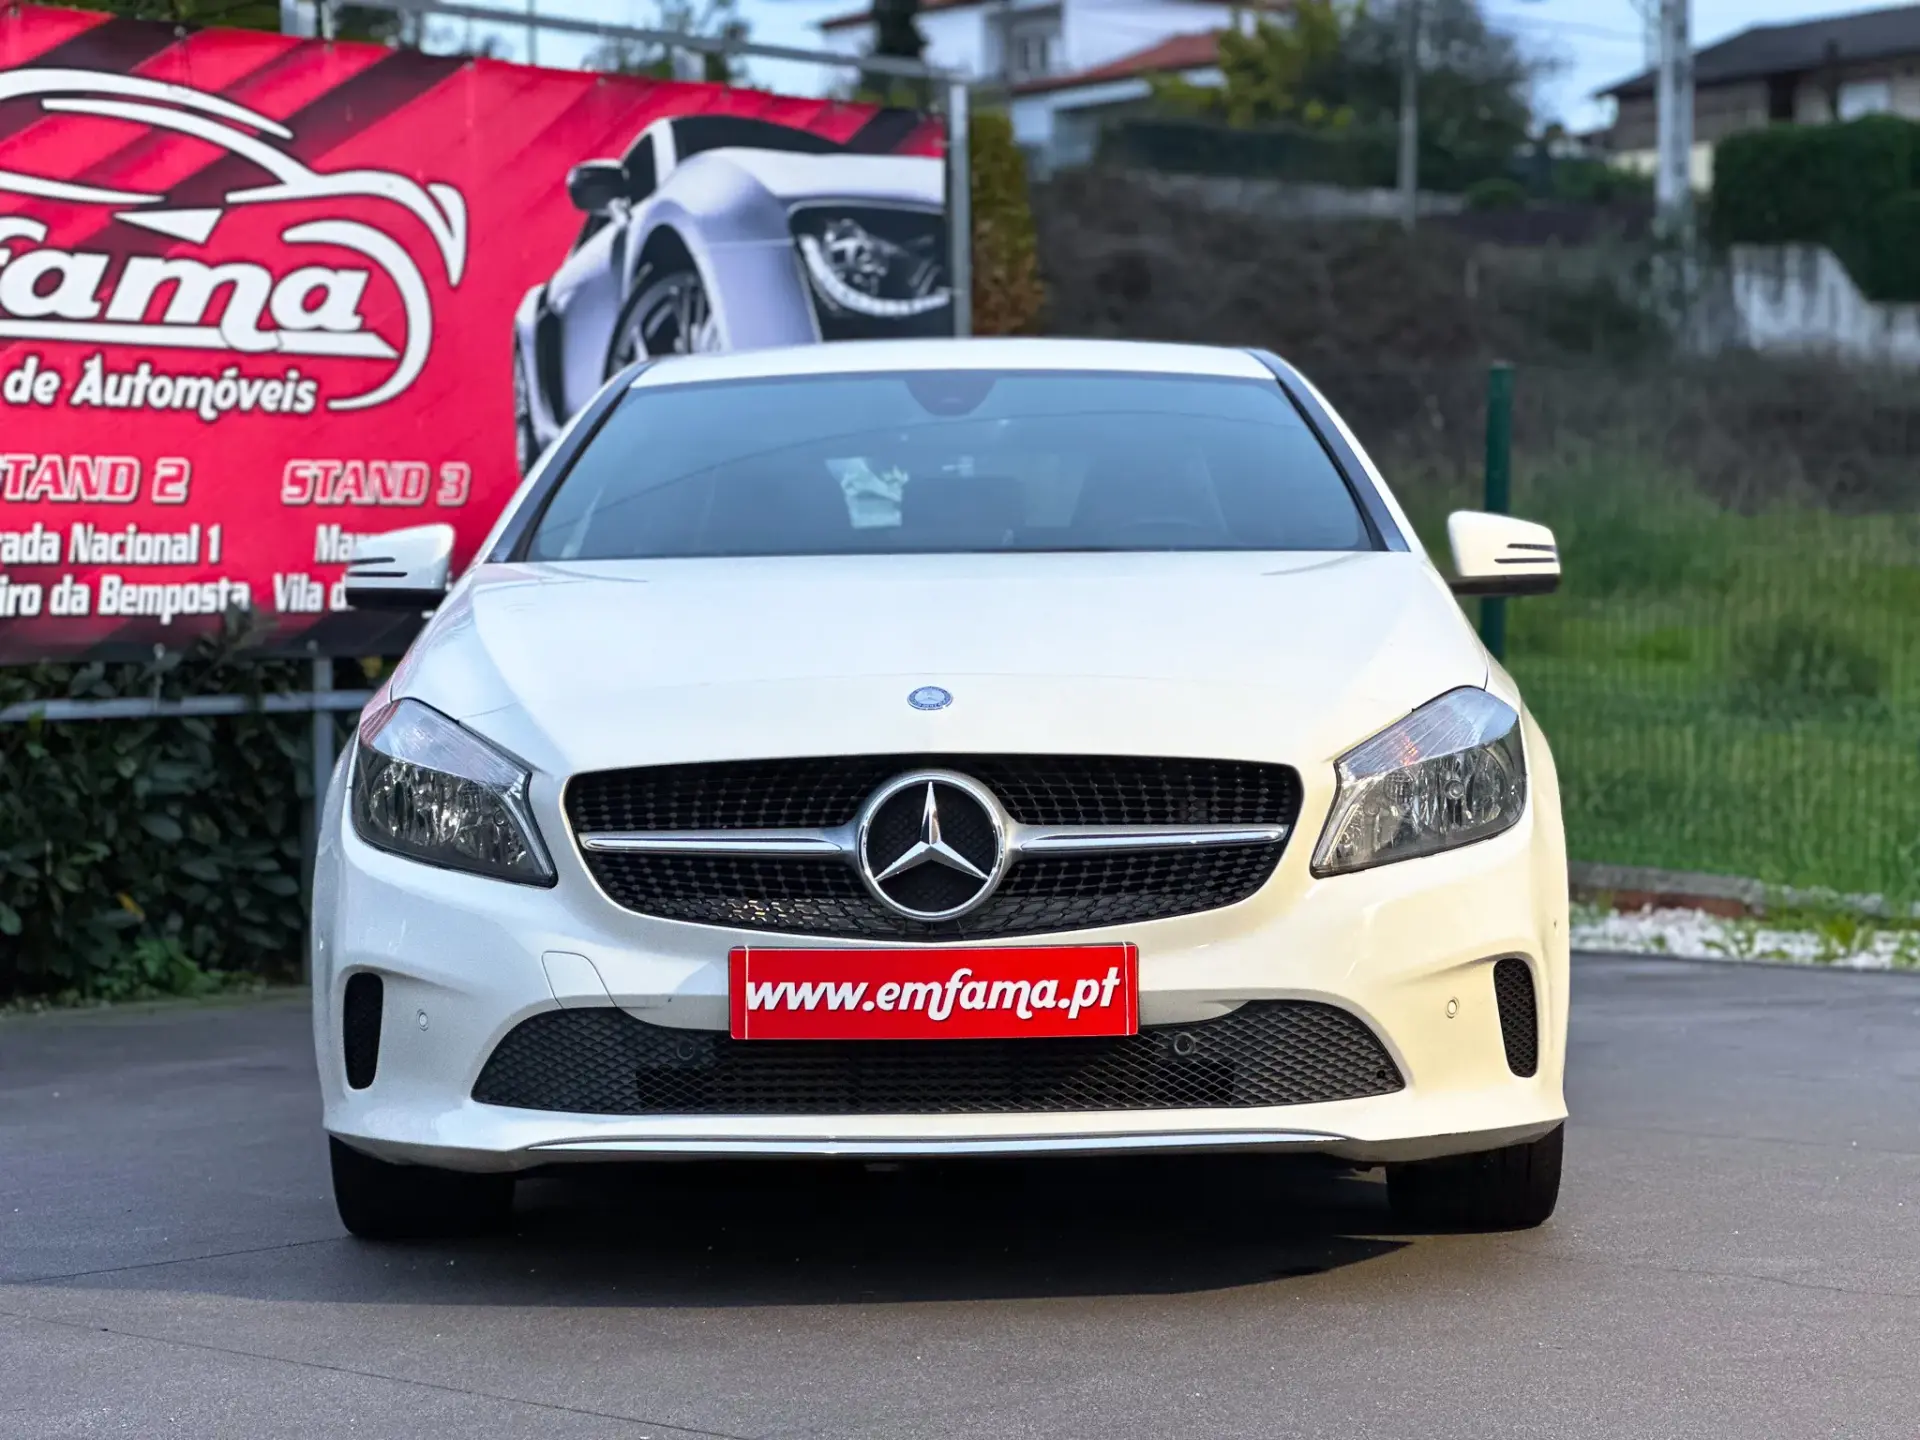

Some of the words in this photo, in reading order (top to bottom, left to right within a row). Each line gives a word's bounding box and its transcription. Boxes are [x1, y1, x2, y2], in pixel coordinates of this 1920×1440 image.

[3, 355, 61, 403] de
[70, 352, 318, 421] Automóveis
[0, 453, 141, 502] TAND
[152, 457, 190, 503] 2
[280, 459, 429, 505] STAND
[436, 461, 471, 506] 3
[68, 522, 201, 564] Nacional
[207, 523, 222, 563] 1
[50, 573, 91, 616] da
[98, 574, 250, 626] Bemposta
[273, 572, 324, 613] Vila
[329, 573, 356, 612] d
[747, 966, 1121, 1021] www.emfama.pt
